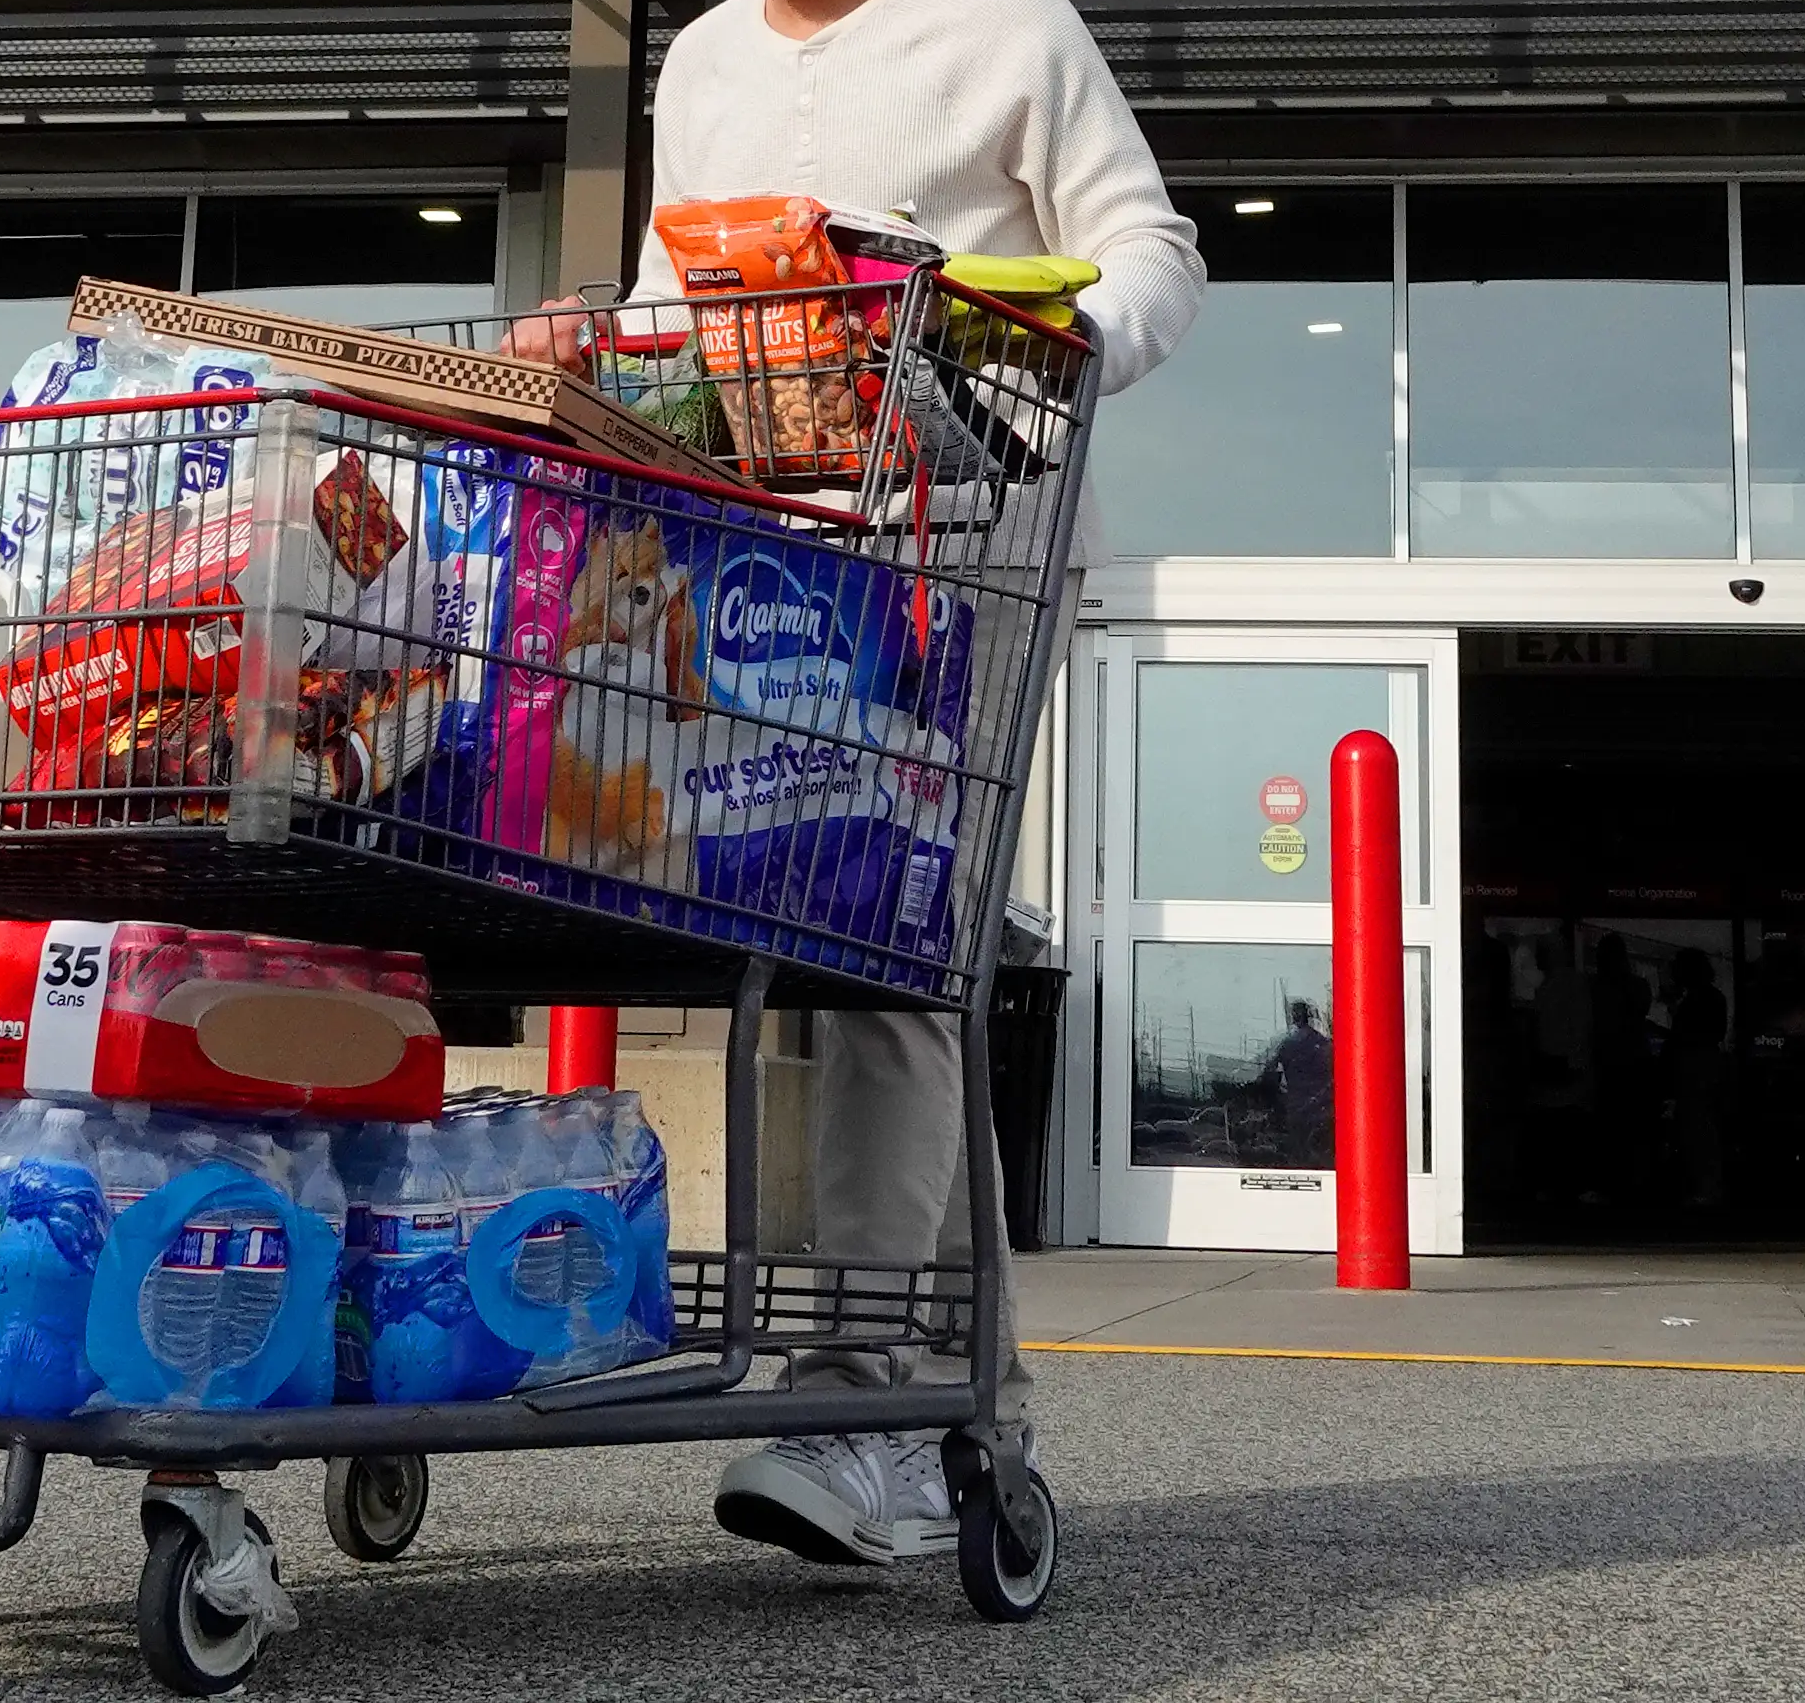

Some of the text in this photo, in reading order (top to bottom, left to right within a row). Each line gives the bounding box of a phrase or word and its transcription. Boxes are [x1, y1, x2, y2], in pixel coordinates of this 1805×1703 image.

[686, 269, 741, 283] KIRKLAND
[195, 314, 422, 375] FRESH BAKED PIZZA
[804, 339, 836, 354] ECANS
[719, 585, 823, 645] Charmin
[1515, 635, 1637, 663] EXIT
[757, 672, 842, 702] Ultra Soft
[39, 679, 123, 716] CHIKEN AUSAE
[684, 762, 736, 795] our
[1266, 784, 1300, 794] DO NOT
[726, 794, 740, 810] &
[1269, 806, 1297, 815] ENTER
[1261, 843, 1304, 853] CAUTION
[1477, 884, 1518, 896] Remodel
[1609, 888, 1636, 899] Home
[42, 942, 101, 989] 35
[46, 991, 86, 1007] Cans
[1754, 1034, 1785, 1049] shop
